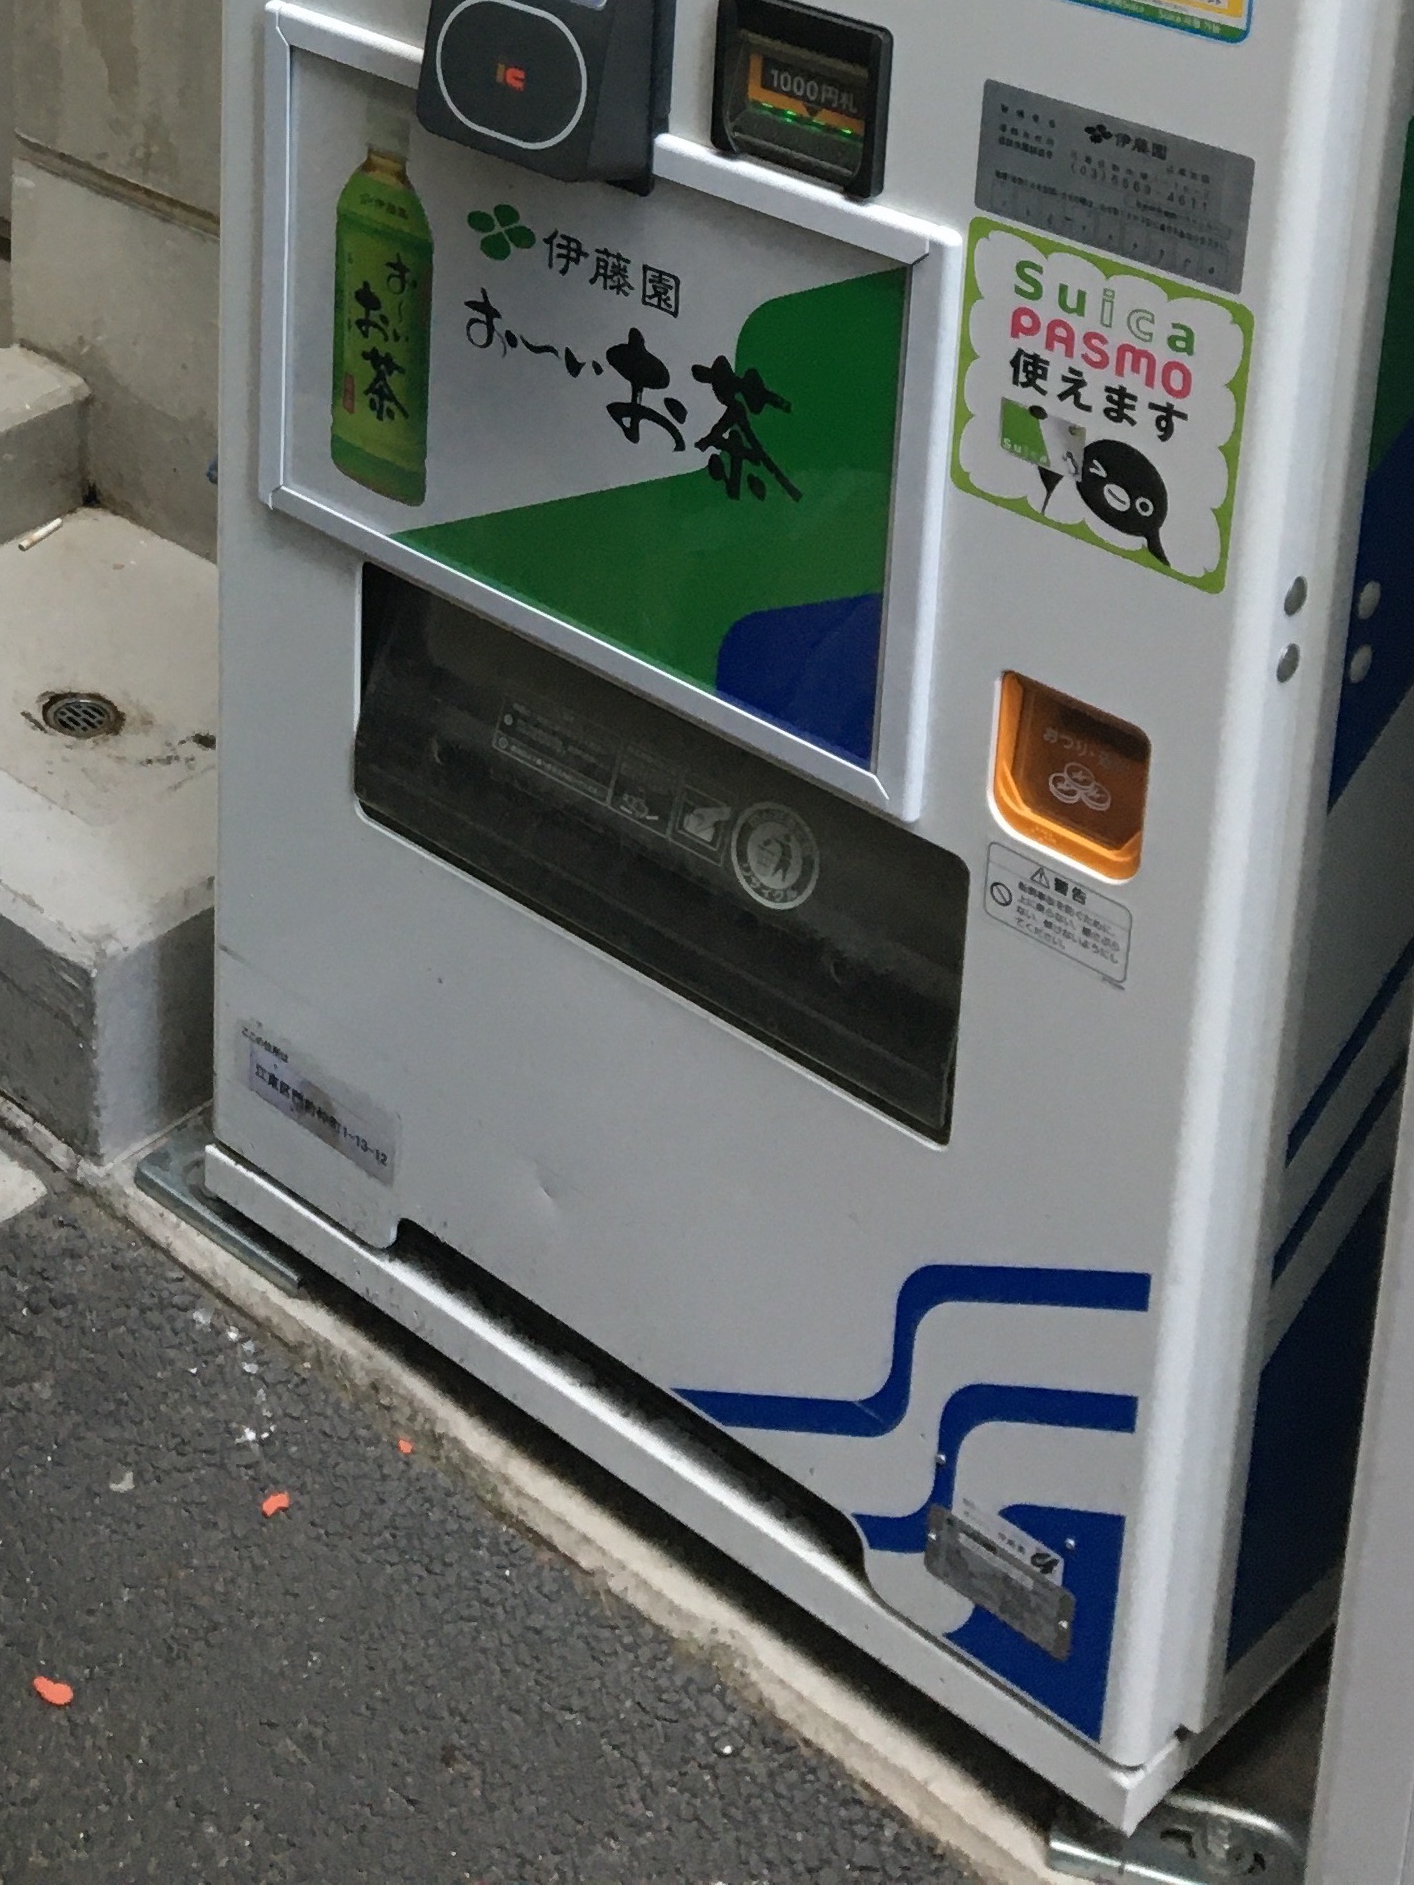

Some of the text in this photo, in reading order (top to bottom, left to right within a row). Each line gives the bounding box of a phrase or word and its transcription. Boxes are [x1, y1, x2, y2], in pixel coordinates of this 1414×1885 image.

[770, 69, 858, 114] 1000円札
[543, 228, 681, 318] 伊藤園
[1014, 259, 1197, 357] Suica
[462, 287, 803, 503] お〜いお茶
[1009, 348, 1189, 442] 使えます
[1010, 305, 1193, 400] PASMO
